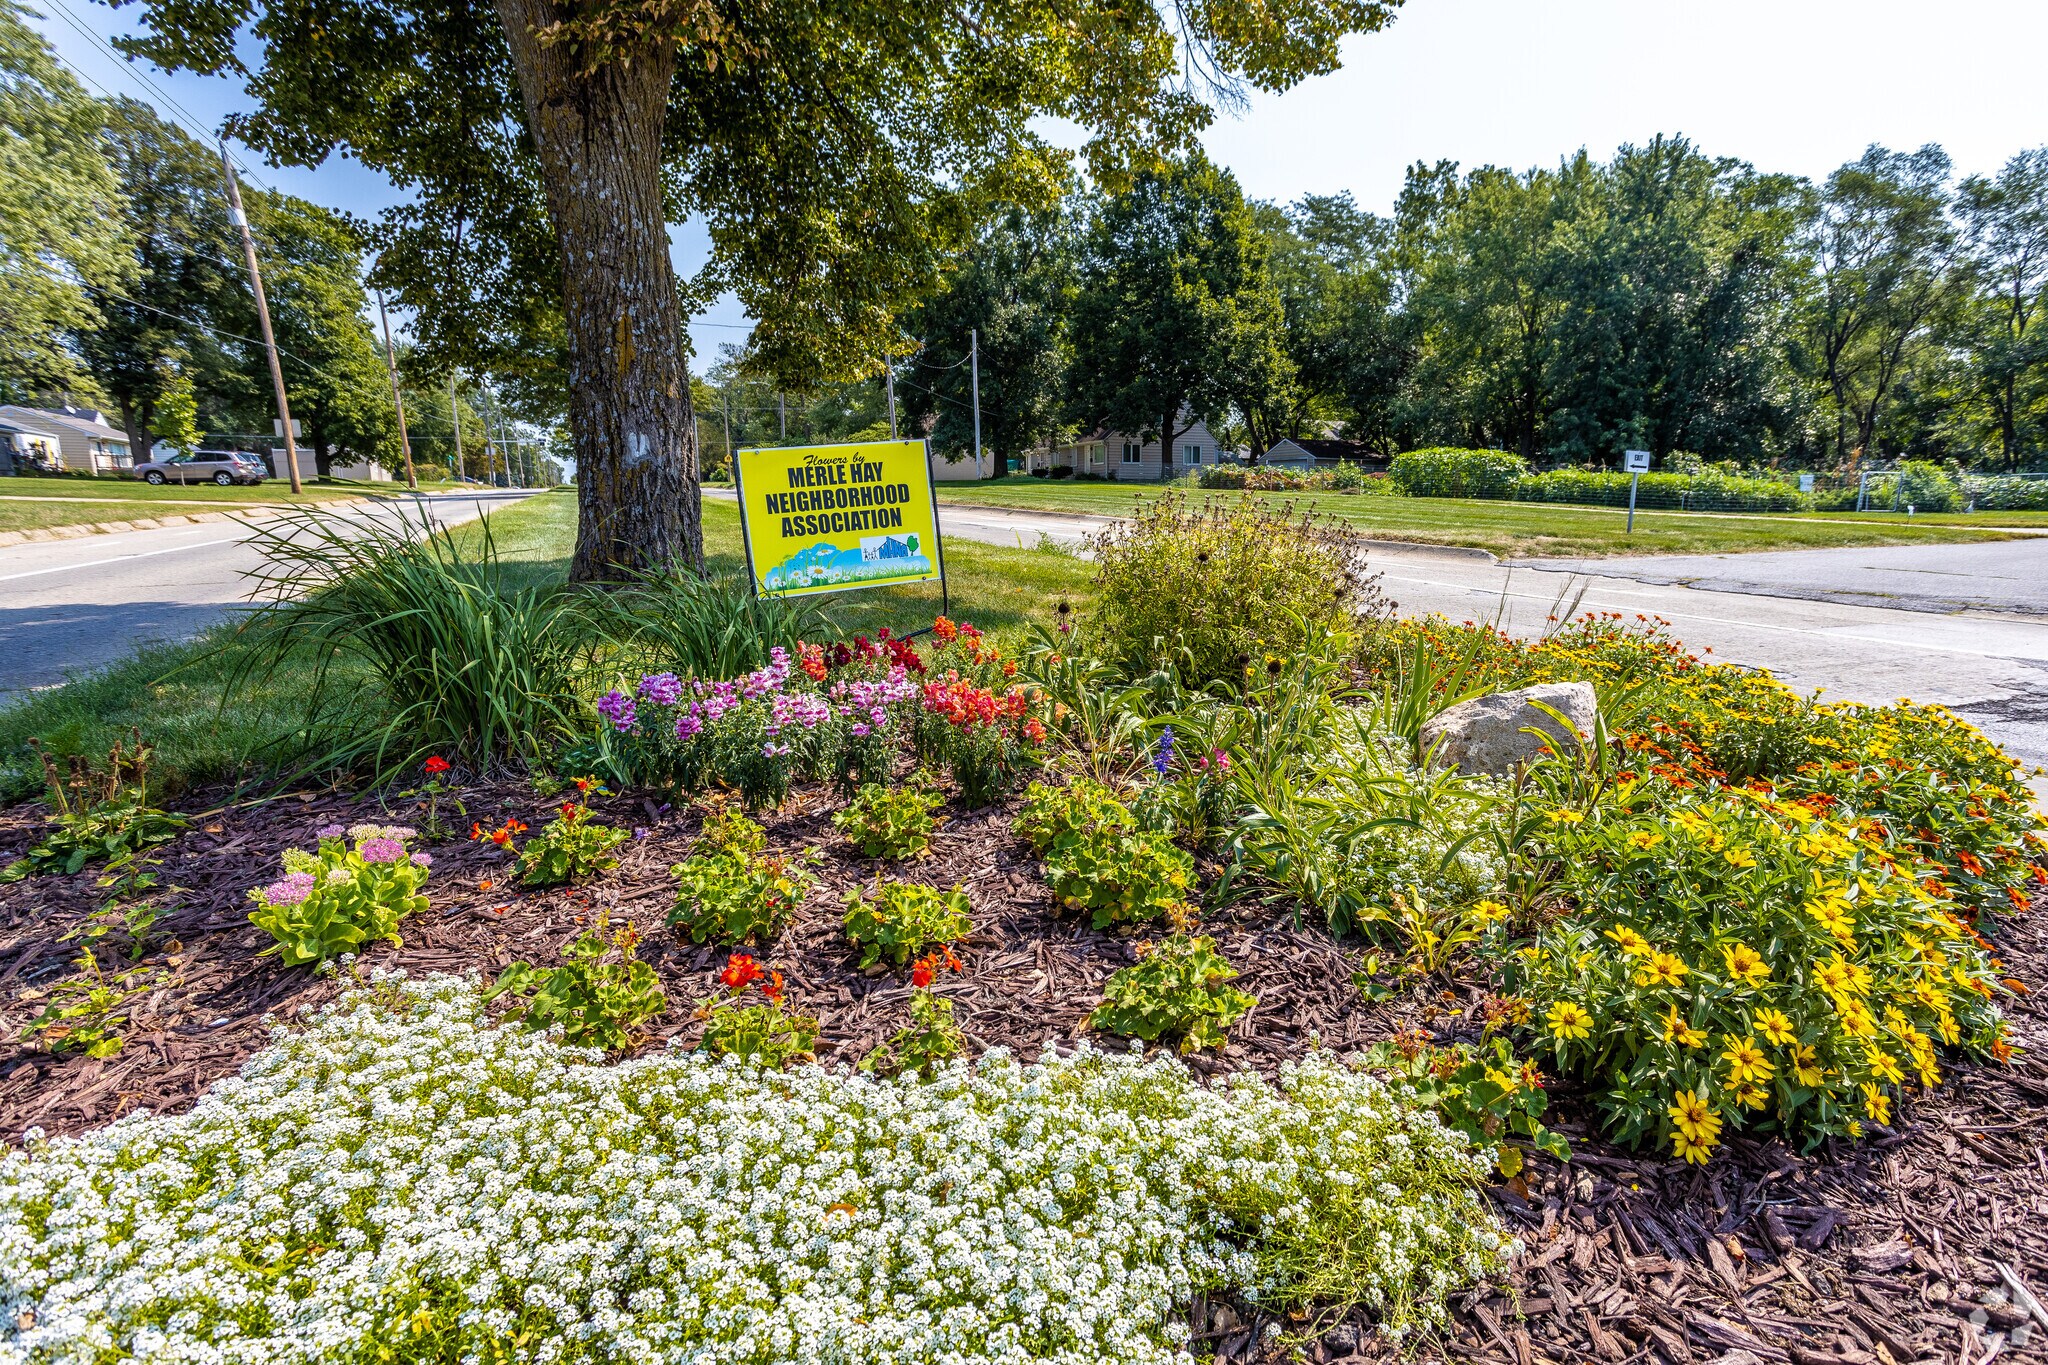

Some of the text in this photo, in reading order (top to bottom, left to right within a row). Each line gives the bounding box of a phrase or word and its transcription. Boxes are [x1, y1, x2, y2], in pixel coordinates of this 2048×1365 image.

[803, 452, 865, 467] Flowers by
[788, 462, 883, 488] MERLE HAY
[766, 484, 910, 514] NEIGHBORHOOD
[782, 508, 903, 537] ASSOCIATION
